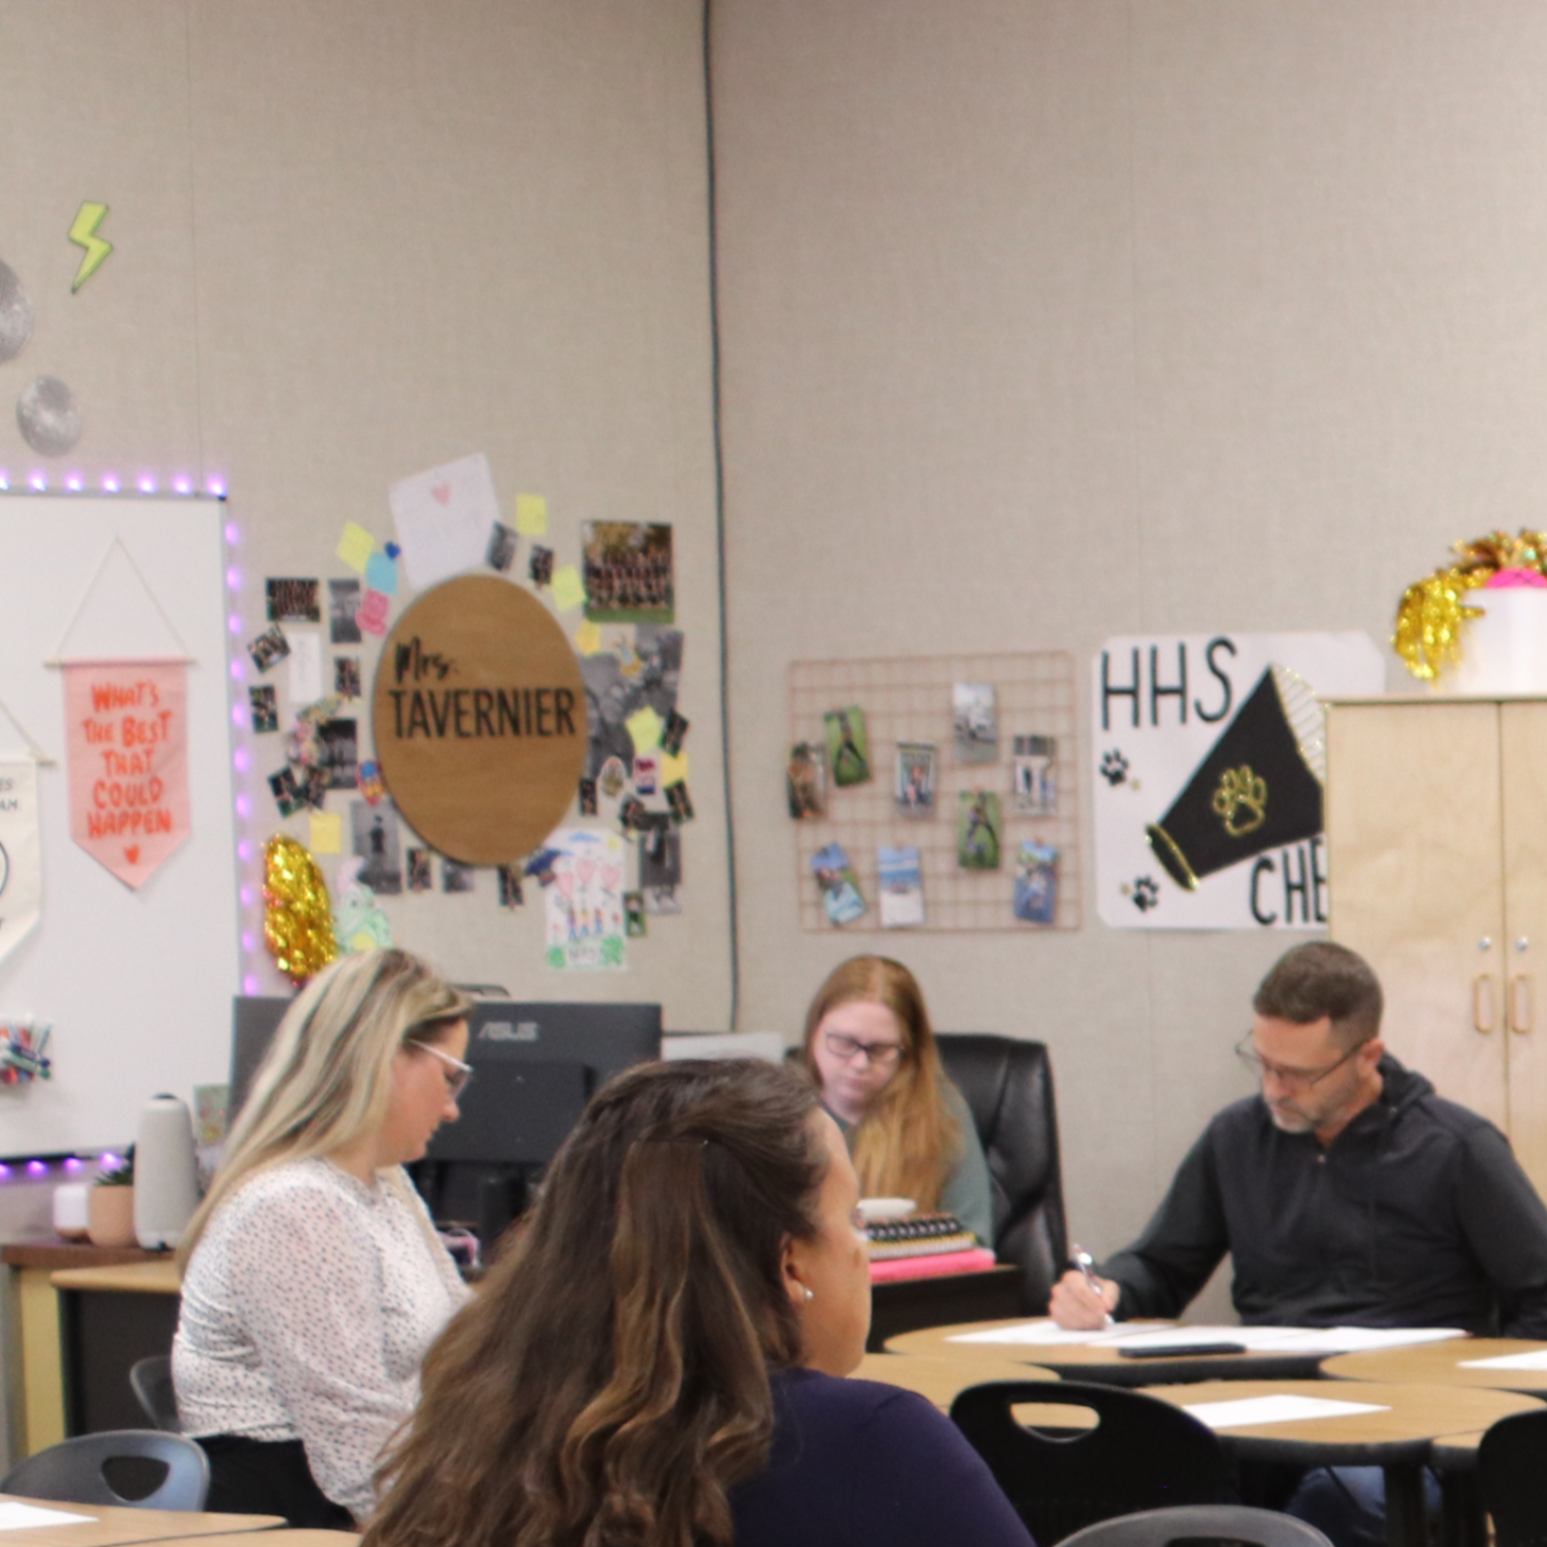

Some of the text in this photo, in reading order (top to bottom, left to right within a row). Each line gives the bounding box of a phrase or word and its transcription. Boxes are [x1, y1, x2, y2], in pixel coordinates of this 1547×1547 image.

[1101, 636, 1237, 731] HHS
[82, 711, 173, 748] THE BEST
[388, 687, 576, 740] TAVERNIER
[92, 776, 164, 810] COULD
[87, 809, 172, 840] HAPPEN
